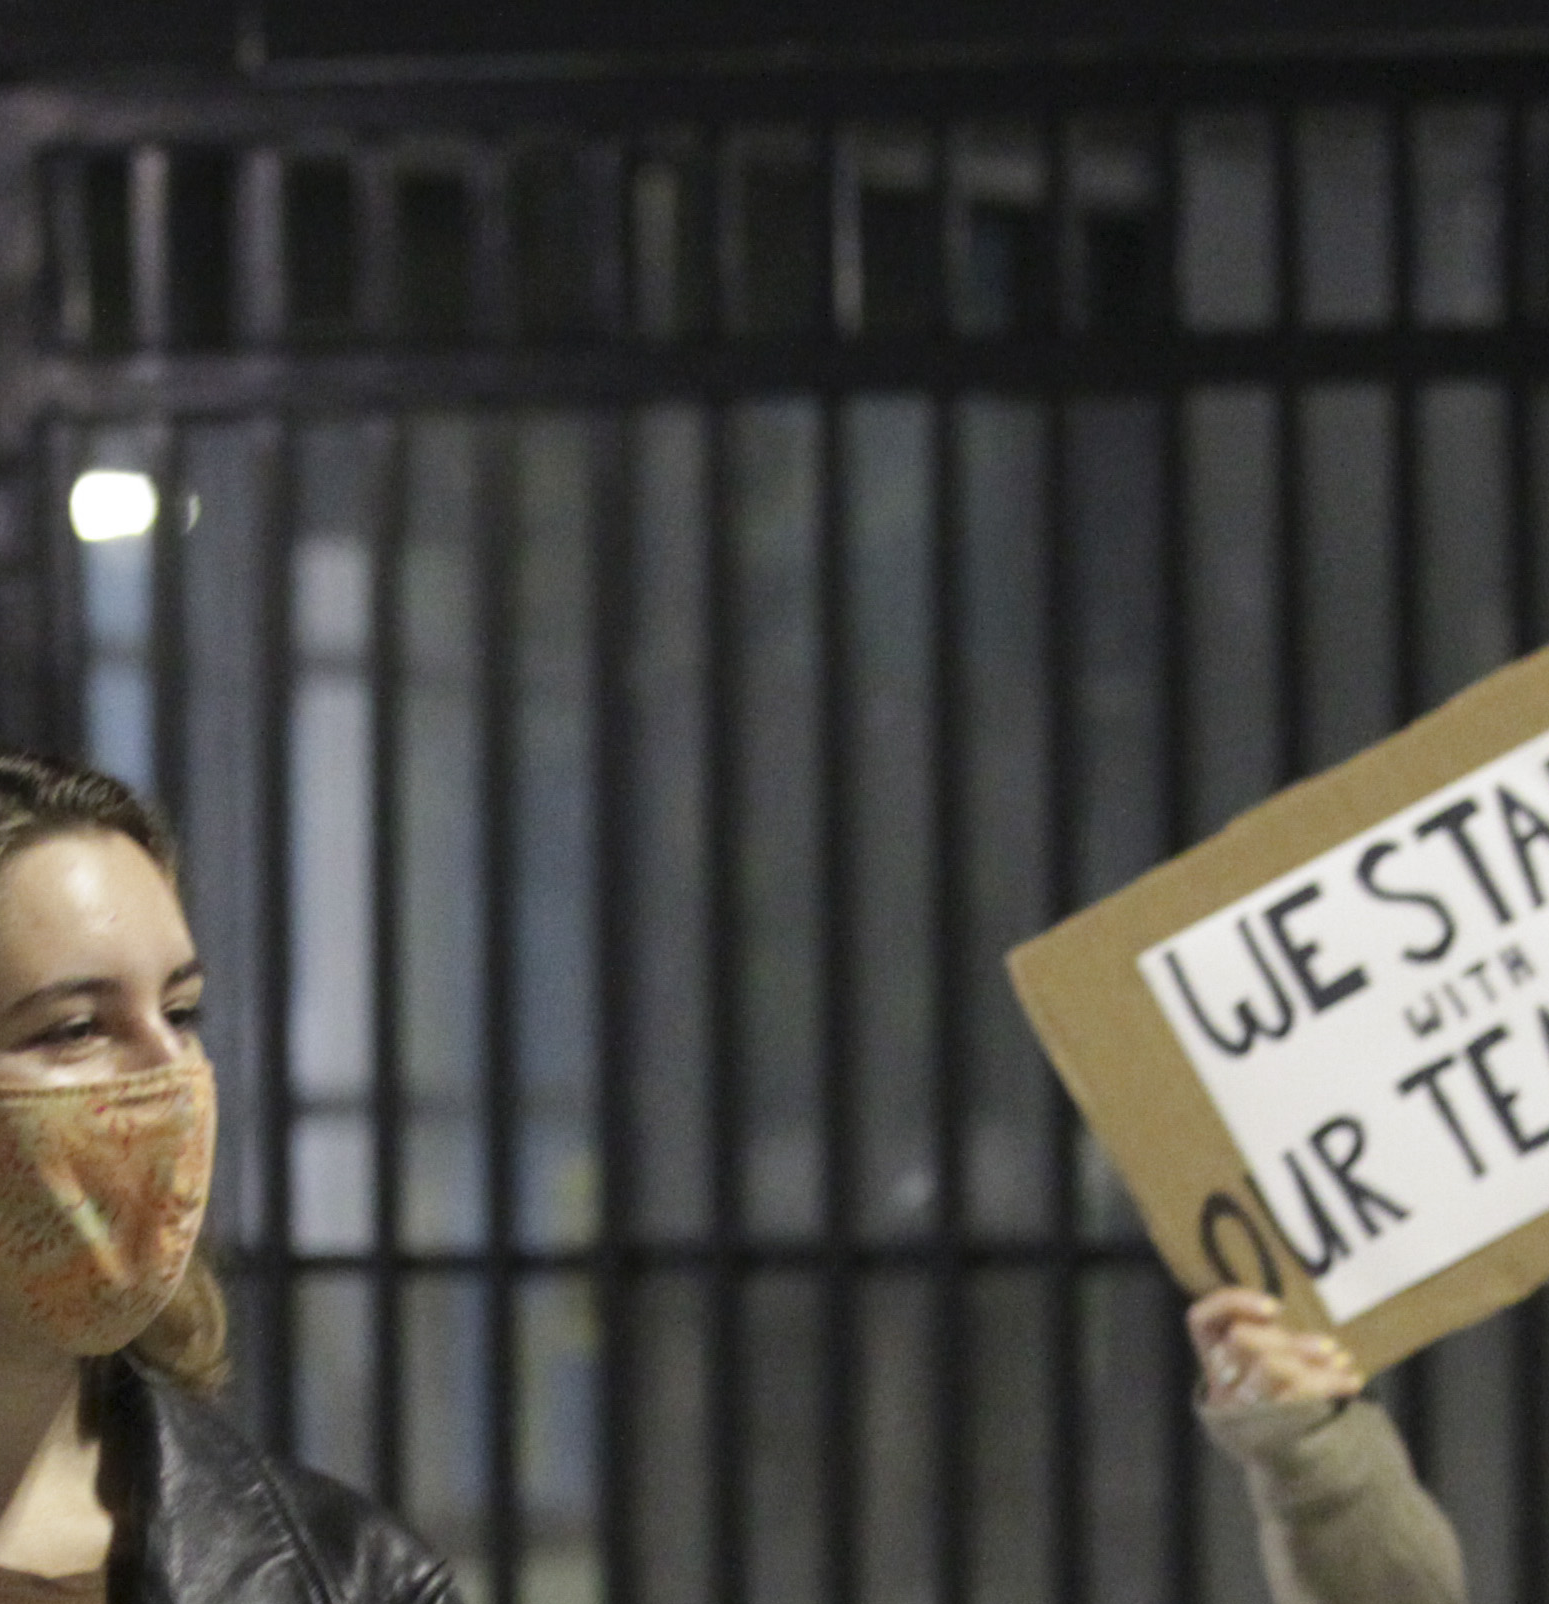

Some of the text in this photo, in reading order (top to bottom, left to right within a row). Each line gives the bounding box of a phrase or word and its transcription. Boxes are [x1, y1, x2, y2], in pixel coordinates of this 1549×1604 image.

[1163, 882, 1370, 1060] WE
[1405, 944, 1536, 1037] WITH
[1199, 1113, 1411, 1300] OUR
